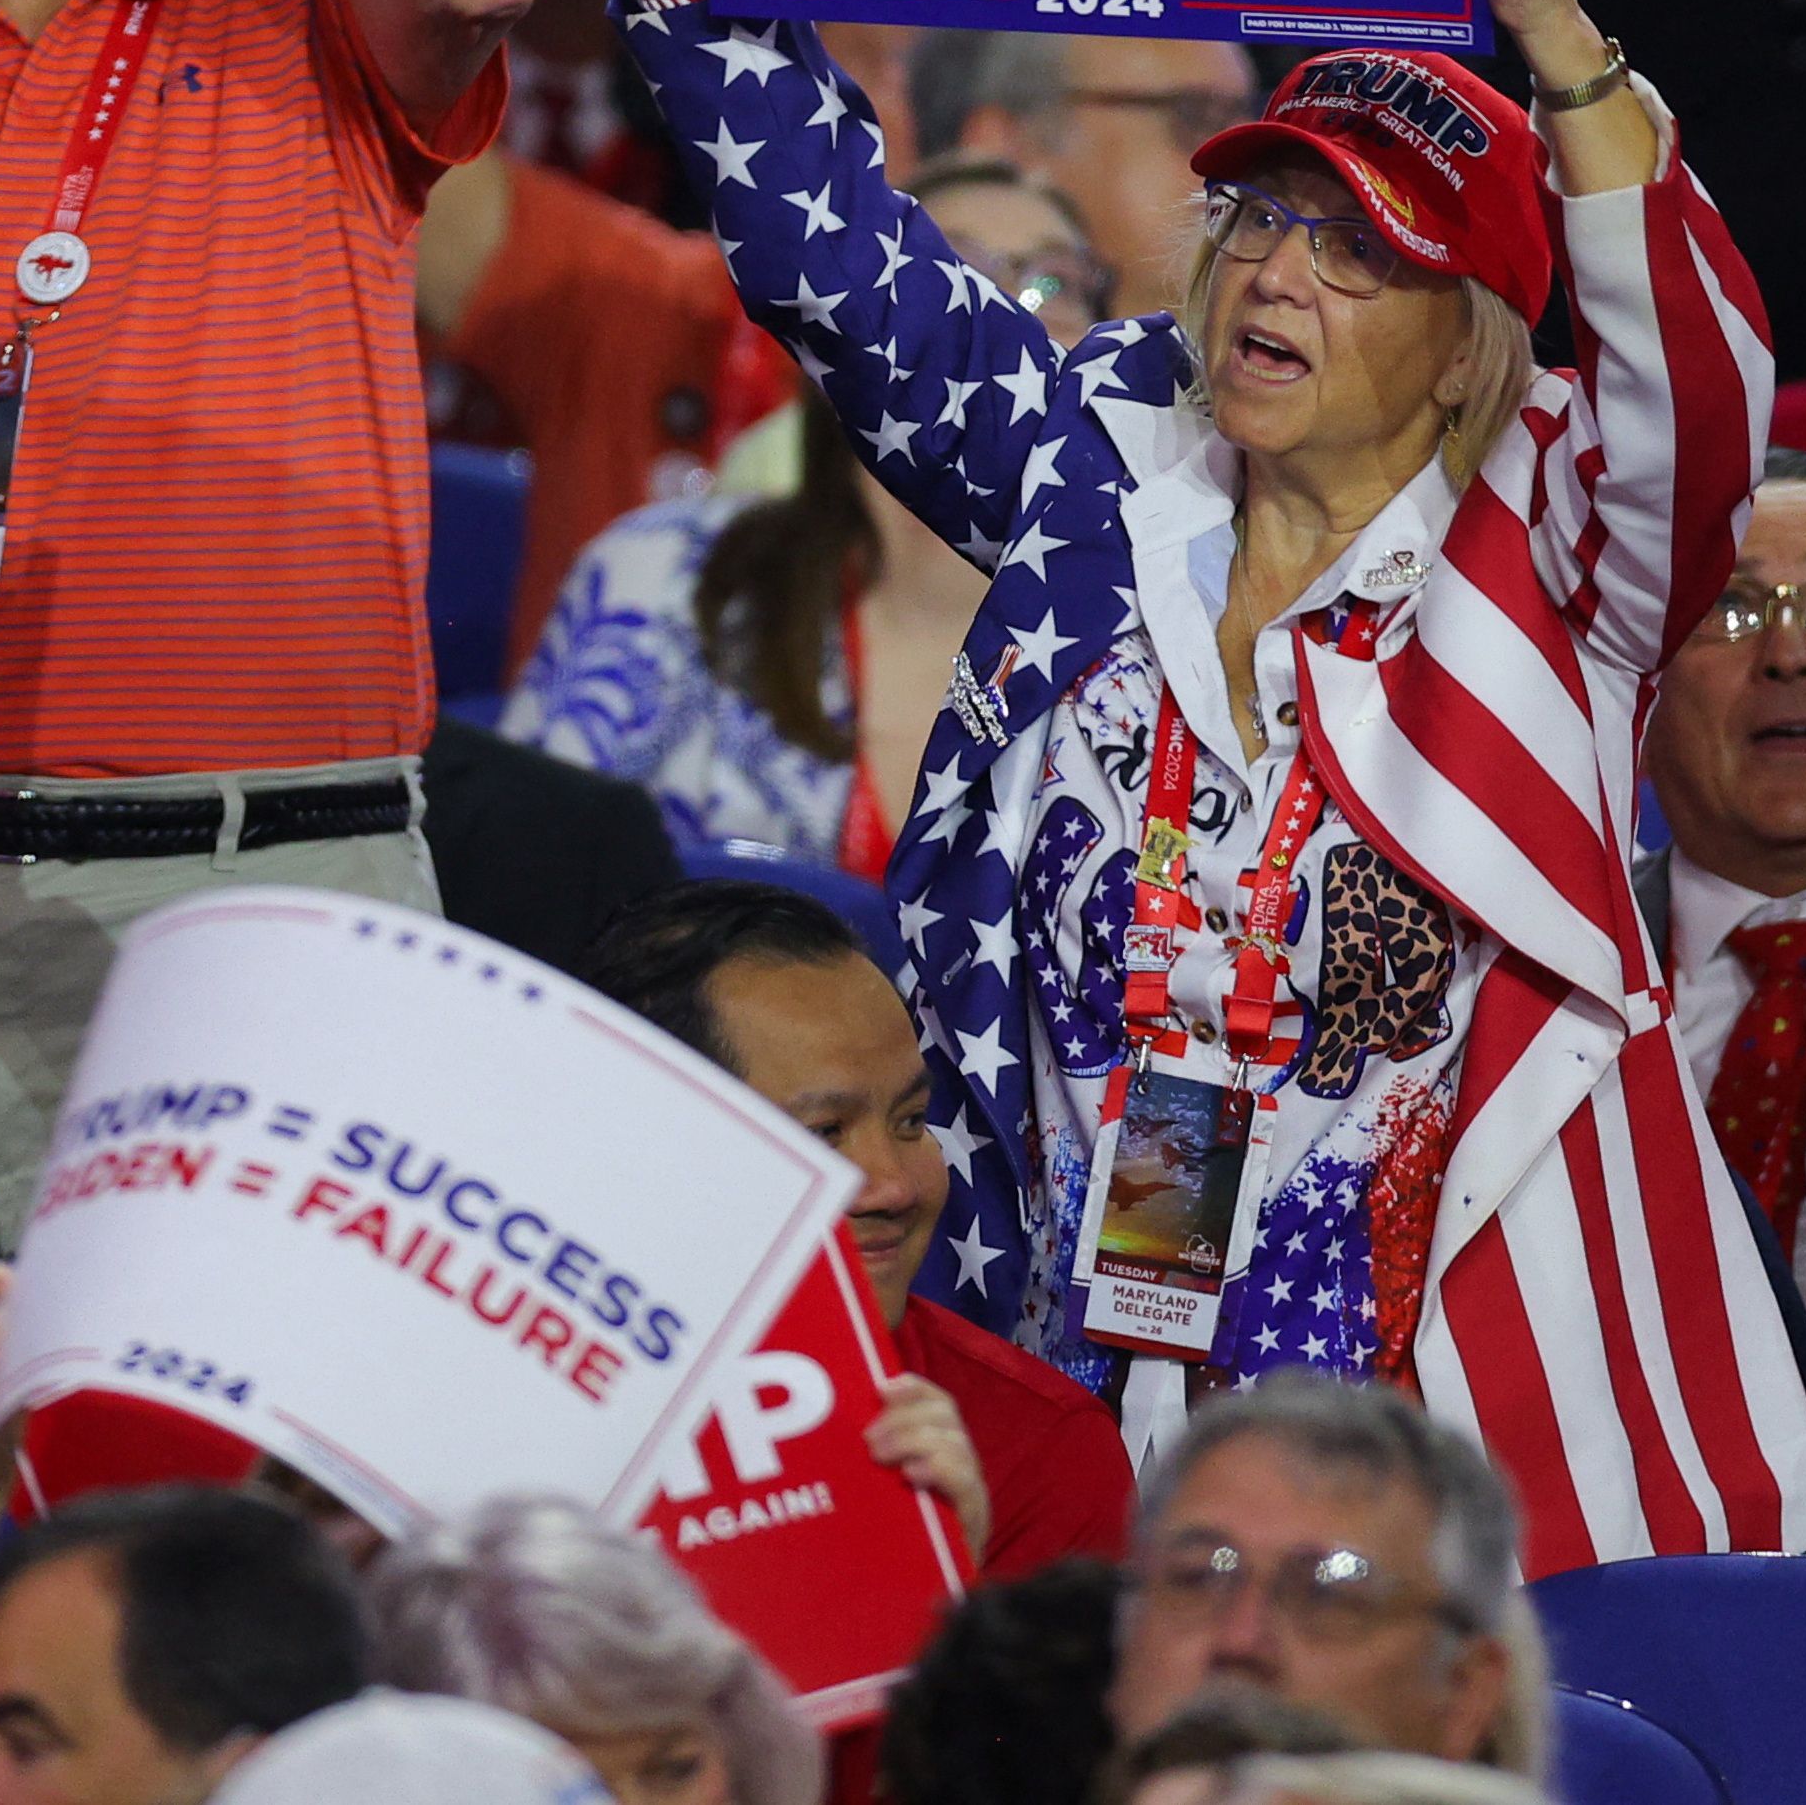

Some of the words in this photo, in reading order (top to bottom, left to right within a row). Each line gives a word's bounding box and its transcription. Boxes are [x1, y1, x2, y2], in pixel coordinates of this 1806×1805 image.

[1294, 60, 1489, 158] TRUMP
[1311, 96, 1372, 116] AMERICA
[1375, 111, 1424, 148] GREAT
[1421, 145, 1465, 192] AGAIN
[1163, 716, 1185, 791] RNC2024
[1251, 886, 1272, 924] DATA
[1264, 876, 1284, 925] TRUST
[328, 1122, 687, 1366] SUCCESS
[1101, 1261, 1157, 1281] TUESDAY
[290, 1174, 628, 1405] FAILURE
[1113, 1284, 1198, 1311] MARYLAND
[1113, 1301, 1192, 1326] DELEGATE
[113, 1340, 255, 1409] 2024
[676, 1480, 836, 1551] AGAIN!
